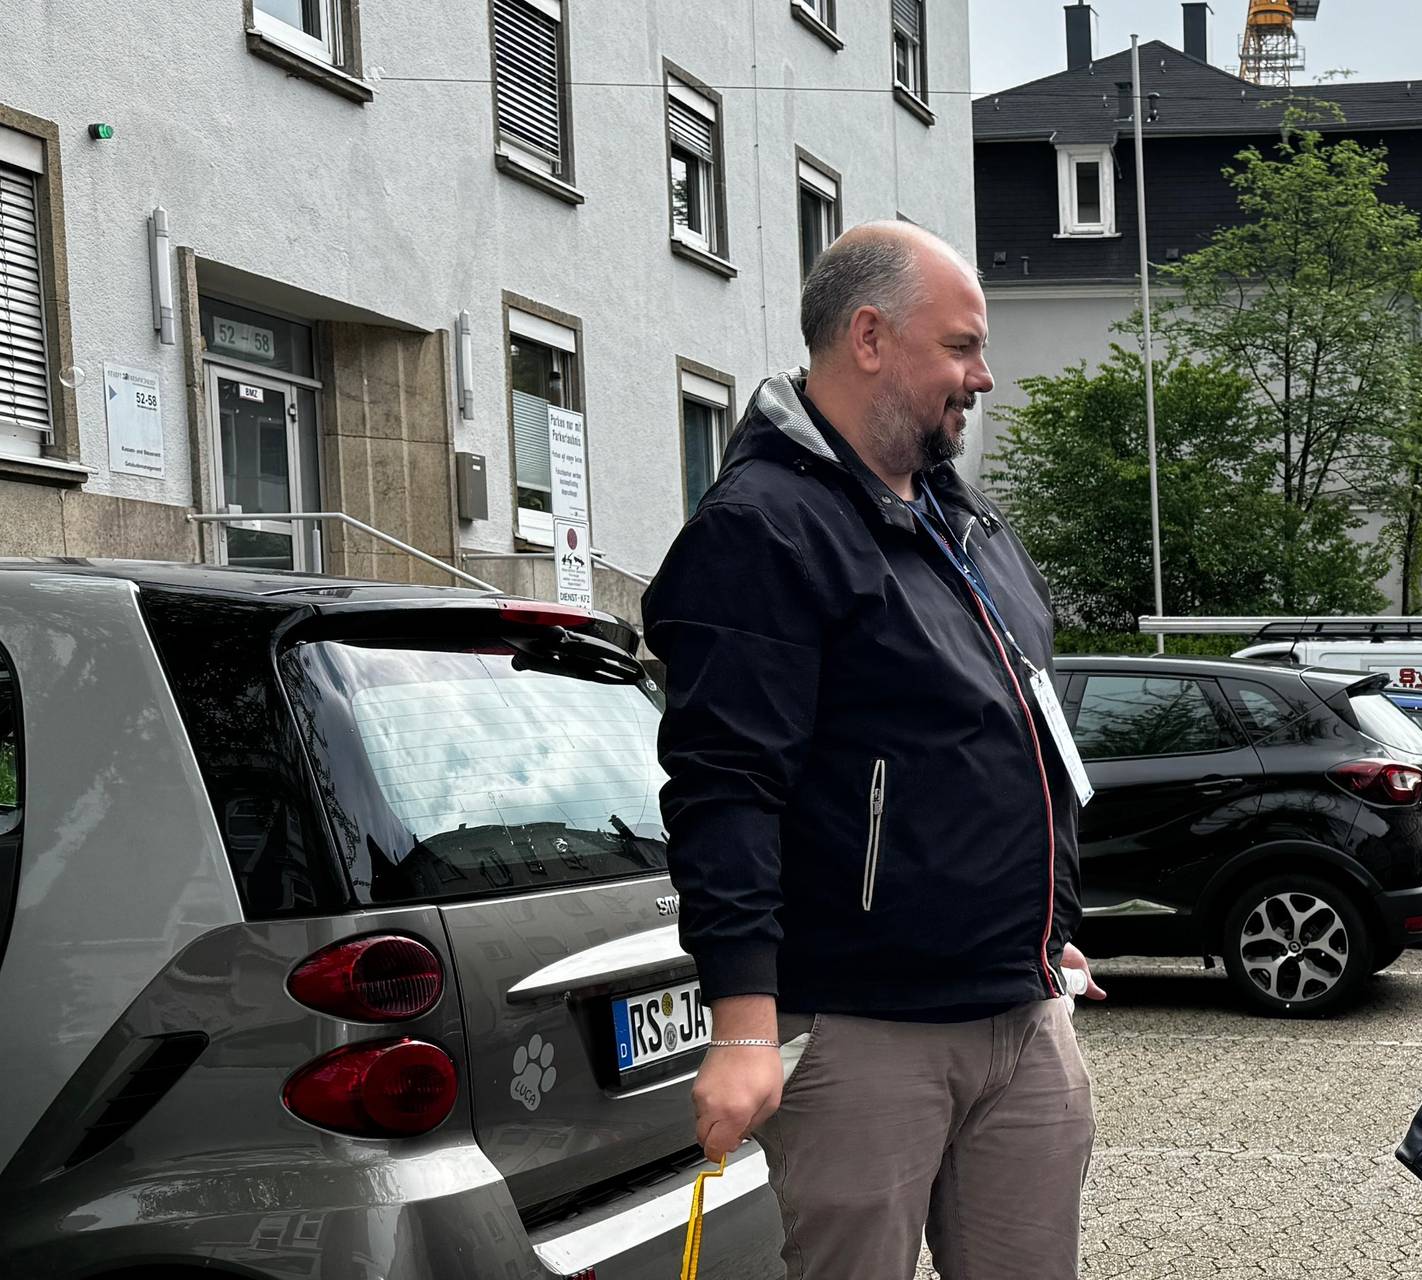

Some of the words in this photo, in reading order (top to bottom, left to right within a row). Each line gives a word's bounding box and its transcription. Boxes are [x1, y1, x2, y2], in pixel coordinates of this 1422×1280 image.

[219, 324, 235, 344] 52
[255, 333, 269, 353] 58
[136, 392, 157, 407] 52-58
[245, 388, 258, 398] BMZ
[629, 1000, 662, 1058] RS
[680, 988, 707, 1042] JA
[620, 1043, 627, 1058] D
[514, 1080, 536, 1106] LUCA
